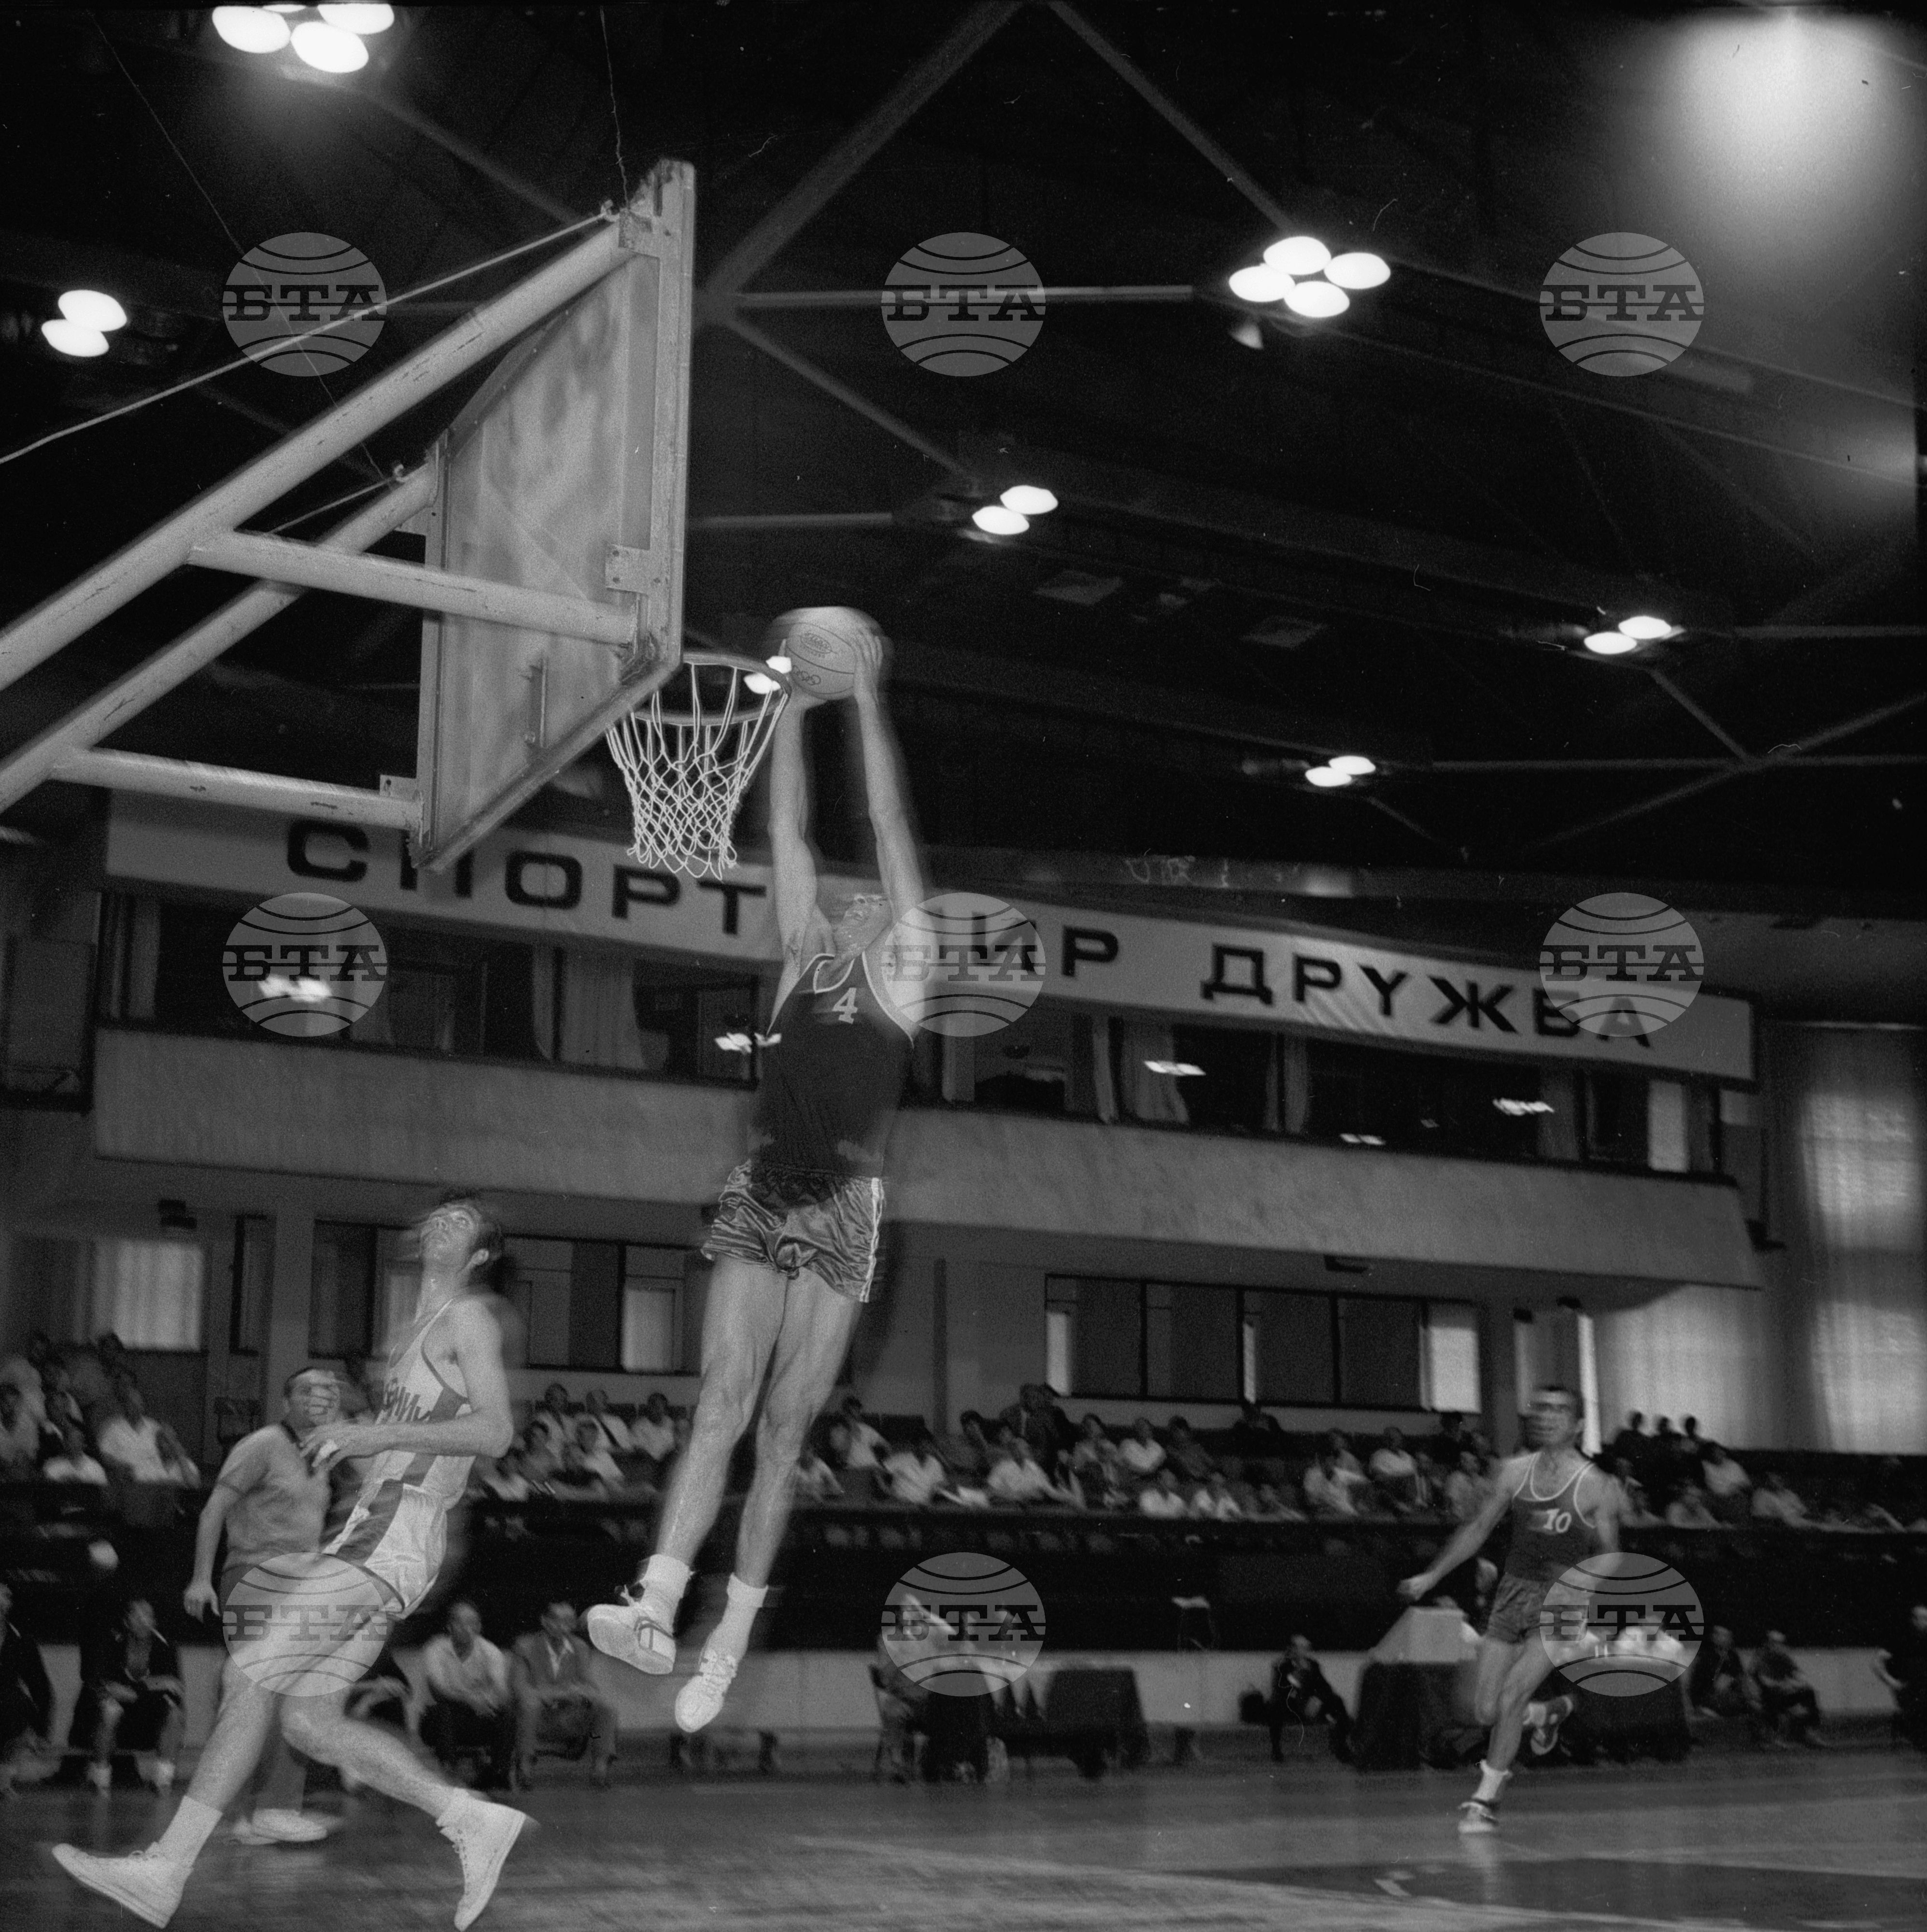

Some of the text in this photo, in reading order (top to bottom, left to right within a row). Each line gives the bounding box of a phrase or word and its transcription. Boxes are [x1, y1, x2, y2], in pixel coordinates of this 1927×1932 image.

[832, 987, 858, 1024] 4
[1200, 943, 1651, 1048] ДРУЖБА
[1544, 1508, 1572, 1533] 10
